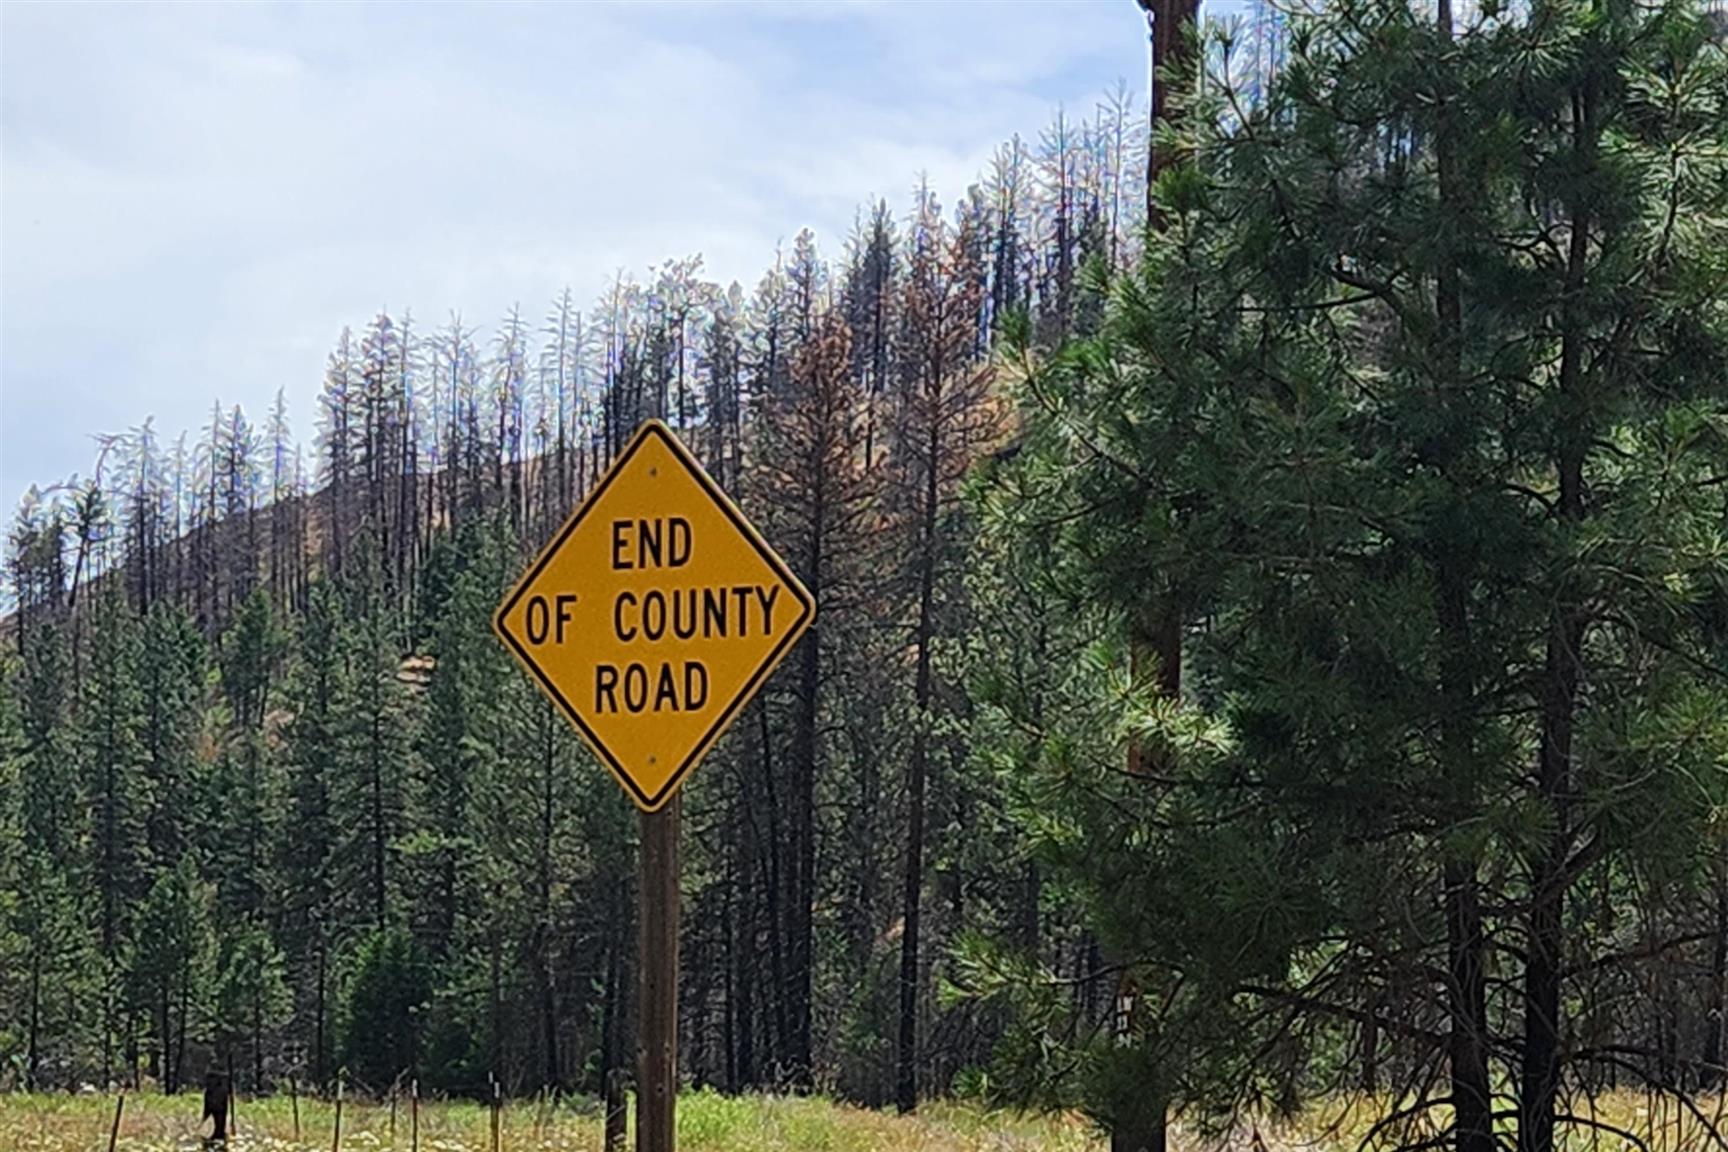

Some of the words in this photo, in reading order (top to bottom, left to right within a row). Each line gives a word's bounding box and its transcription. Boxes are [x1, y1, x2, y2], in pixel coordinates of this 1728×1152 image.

[612, 517, 692, 570] END
[525, 594, 578, 646] OF
[614, 584, 780, 643] COUNTY
[595, 661, 708, 714] ROAD
